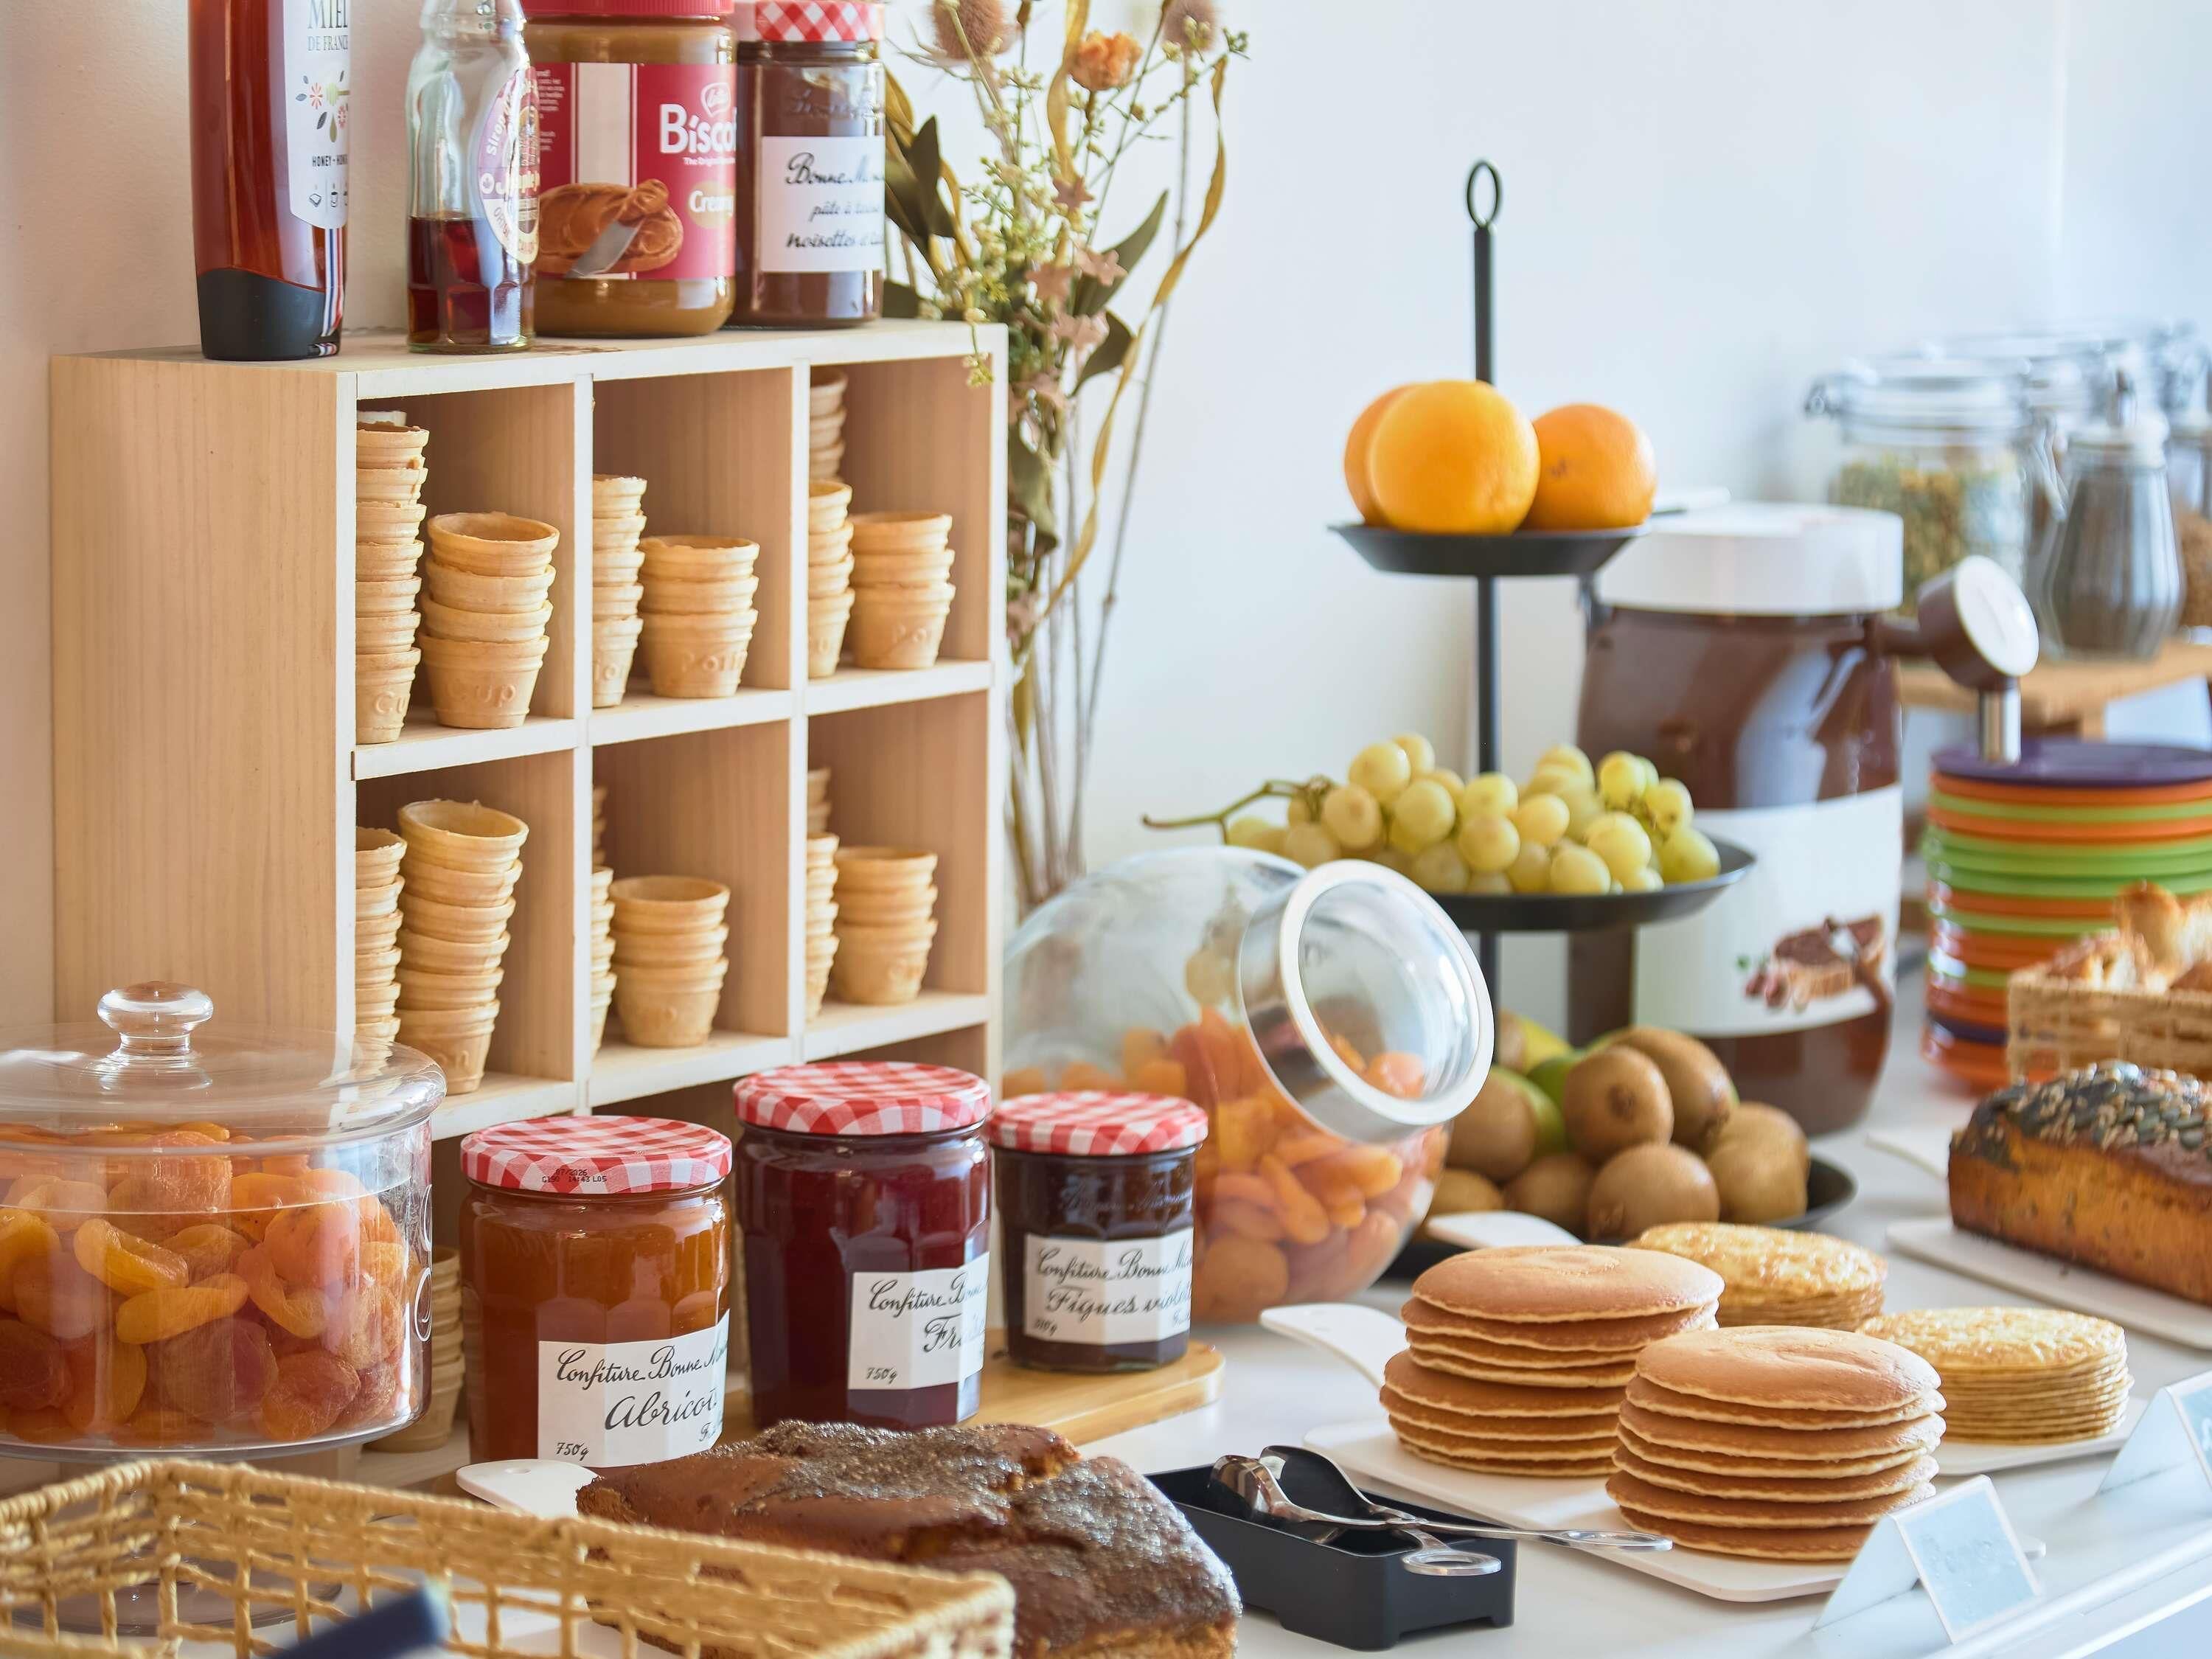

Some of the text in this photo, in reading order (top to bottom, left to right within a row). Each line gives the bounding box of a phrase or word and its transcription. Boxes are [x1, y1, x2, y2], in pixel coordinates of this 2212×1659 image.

[307, 35, 320, 51] DE
[313, 155, 331, 167] HONEY
[1037, 1246, 1113, 1284] Confiture
[1115, 1248, 1169, 1280] Bonne
[868, 1279, 947, 1318] Confiture
[1046, 1284, 1139, 1322] Figues
[557, 1348, 646, 1391] Confiture
[648, 1345, 703, 1380] Bonne
[866, 1366, 898, 1384] 750g
[556, 1441, 590, 1462] 750g
